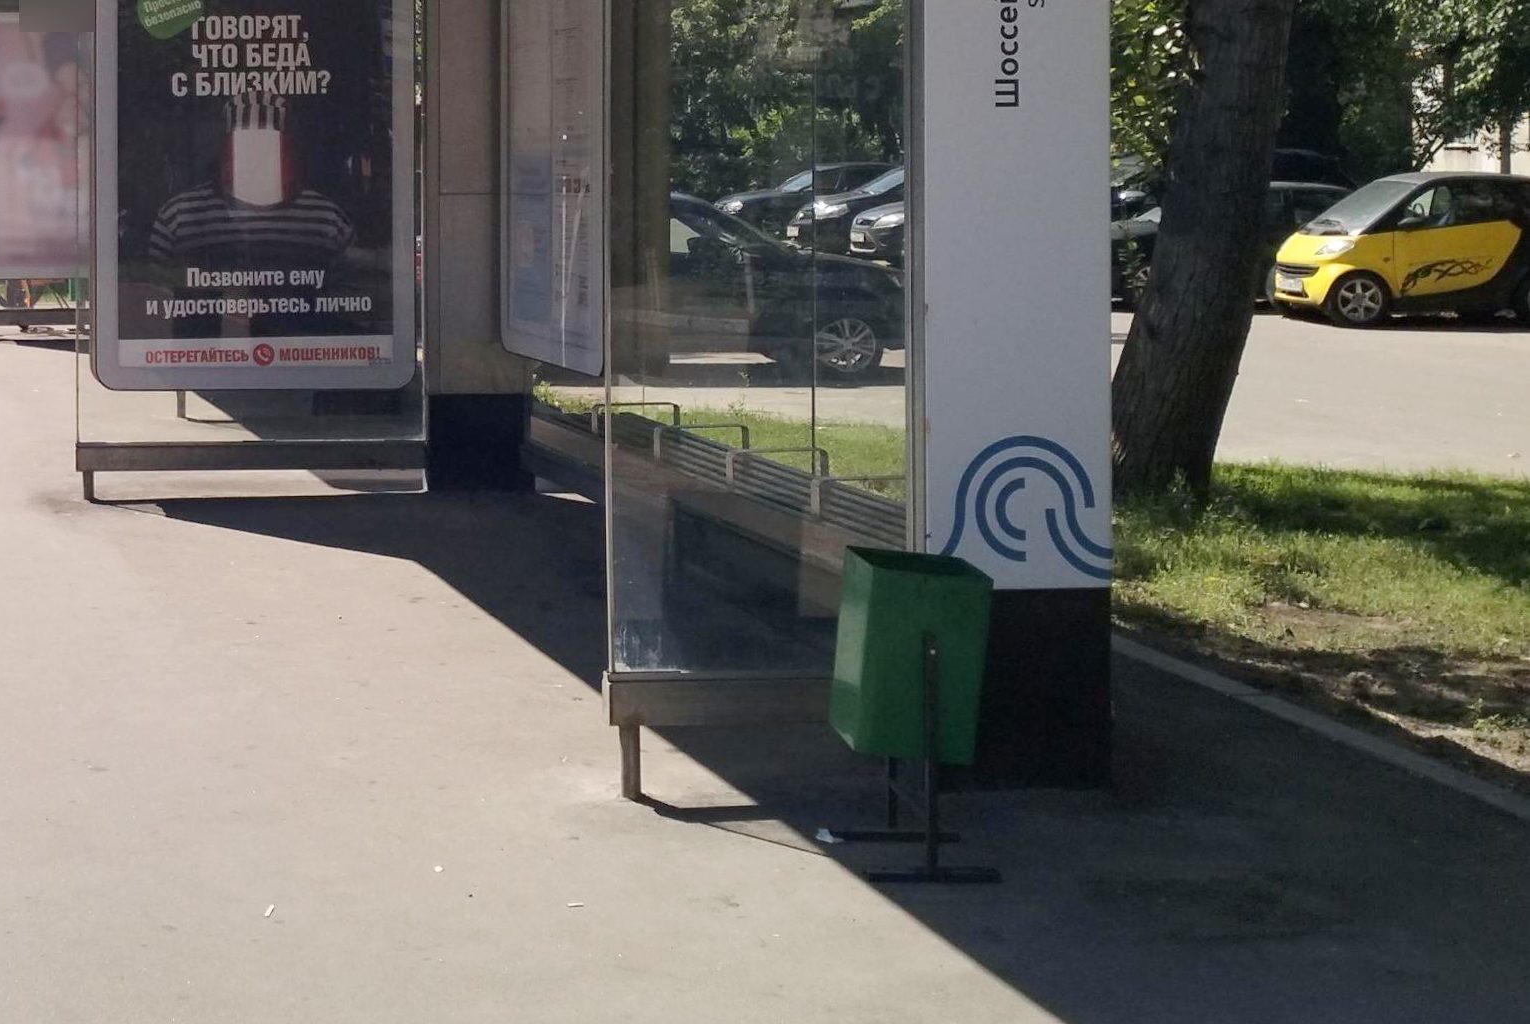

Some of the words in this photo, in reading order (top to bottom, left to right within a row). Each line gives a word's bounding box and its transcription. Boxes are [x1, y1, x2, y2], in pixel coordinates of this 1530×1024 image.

[144, 0, 202, 27] безопасно
[191, 14, 310, 42] ГОВОРЯТ,
[191, 43, 238, 68] ЧТО
[246, 42, 312, 71] БЕДА
[171, 73, 188, 97] С
[195, 70, 332, 97] БЛИЗКИМ?
[186, 267, 285, 288] Позвоните
[289, 269, 325, 289] ему
[146, 300, 158, 315] и
[162, 295, 311, 319] удостоверьтесь
[314, 295, 372, 313] лично
[145, 348, 249, 364] ОСТЕРЕГАЙТЕСЬ
[279, 346, 381, 362] МОШЕННИКОВ!
